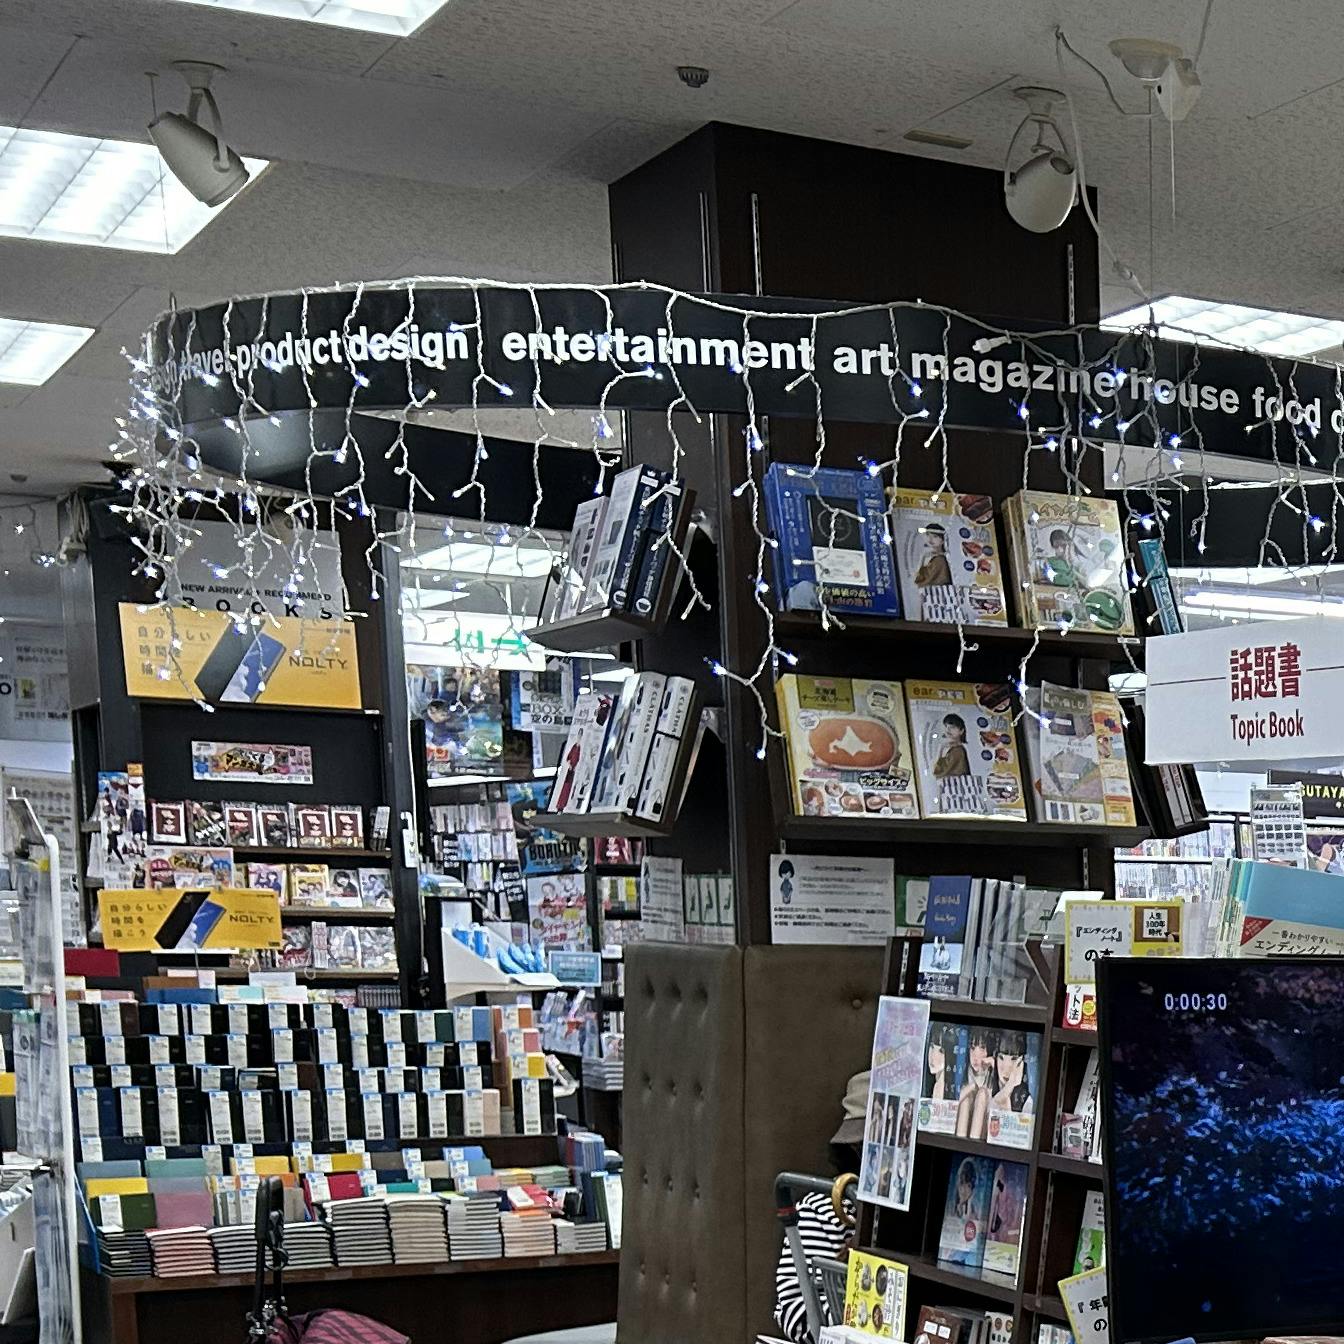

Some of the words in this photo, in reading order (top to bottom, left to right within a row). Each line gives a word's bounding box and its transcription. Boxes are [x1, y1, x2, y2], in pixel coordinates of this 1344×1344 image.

[237, 330, 342, 379] product
[350, 325, 469, 368] design
[503, 323, 815, 373] entertainment
[832, 338, 898, 376] art
[911, 345, 1117, 400] magazine
[1131, 373, 1240, 413] house
[1252, 386, 1321, 430] food
[289, 656, 348, 670] NOLTY
[1229, 641, 1302, 702] 話題書
[1230, 715, 1263, 746] Topic
[1268, 710, 1305, 740] Book
[229, 913, 275, 925] NOLTY
[1164, 992, 1228, 1011] 0:00:30
